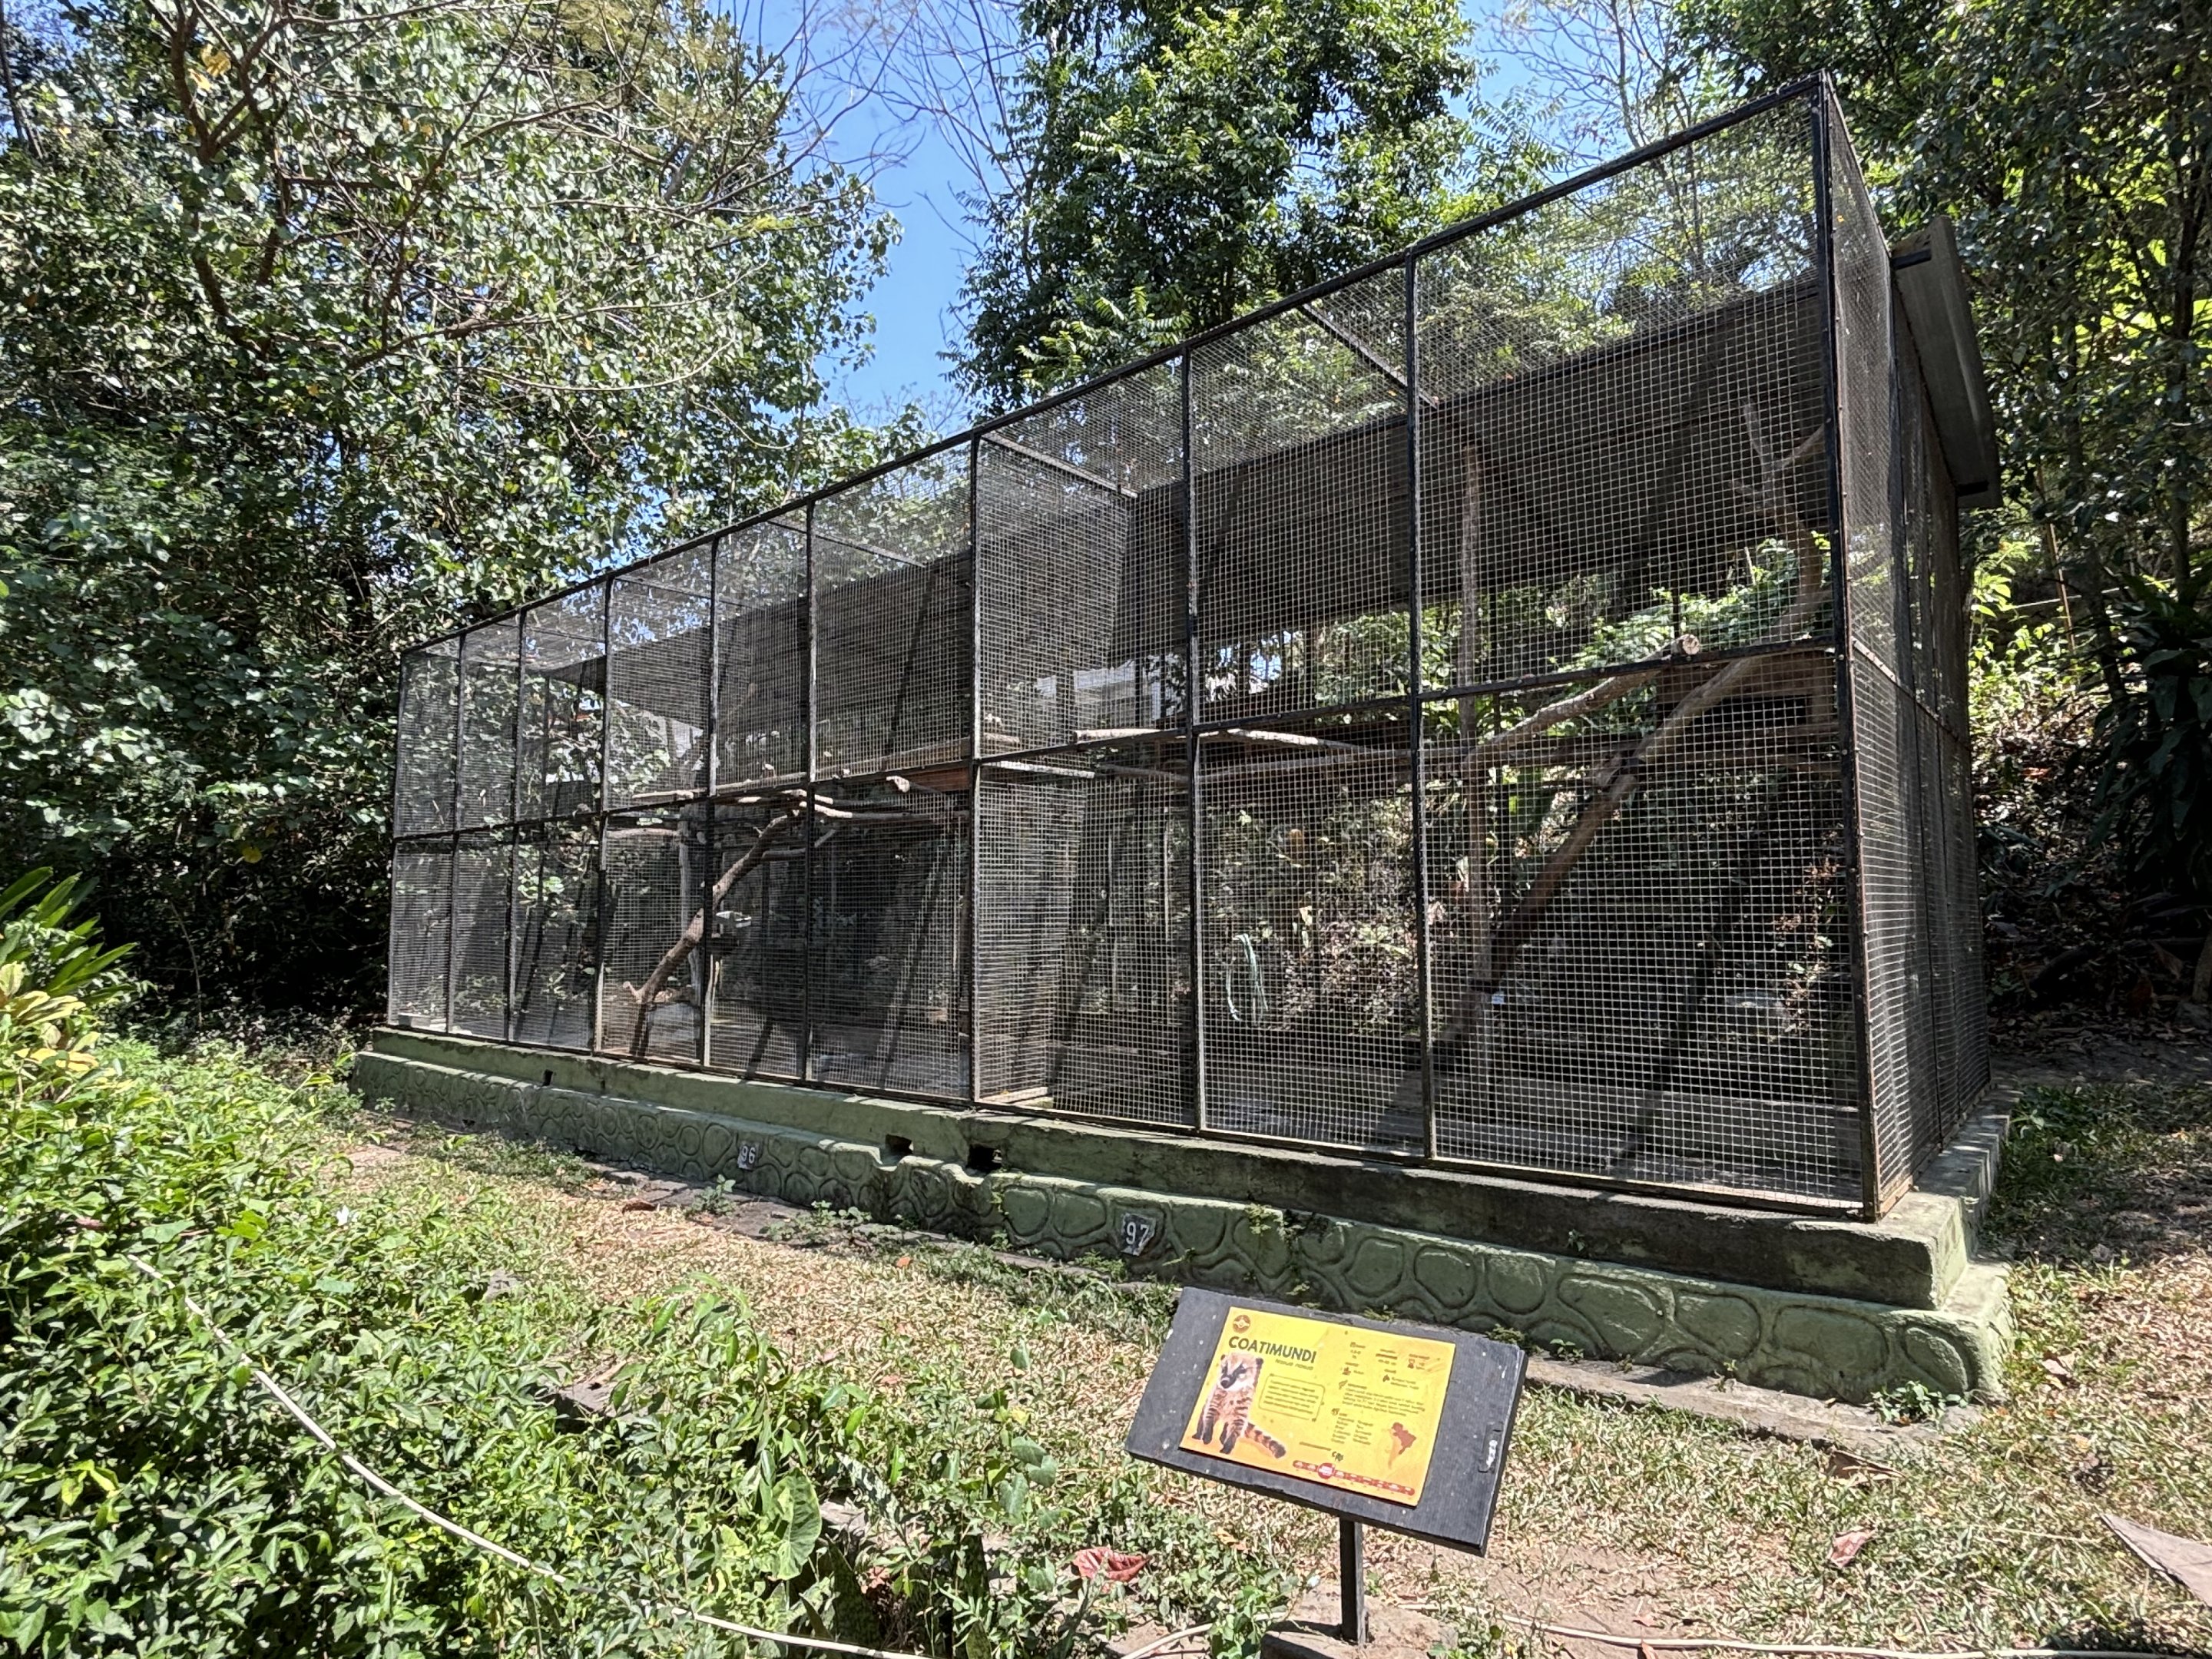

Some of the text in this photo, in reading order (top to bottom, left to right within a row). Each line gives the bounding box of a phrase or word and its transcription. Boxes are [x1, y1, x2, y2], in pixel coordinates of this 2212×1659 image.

[740, 1145, 756, 1164] 96
[1125, 1221, 1150, 1247] 97
[1229, 1336, 1316, 1363] COATIMUNDI
